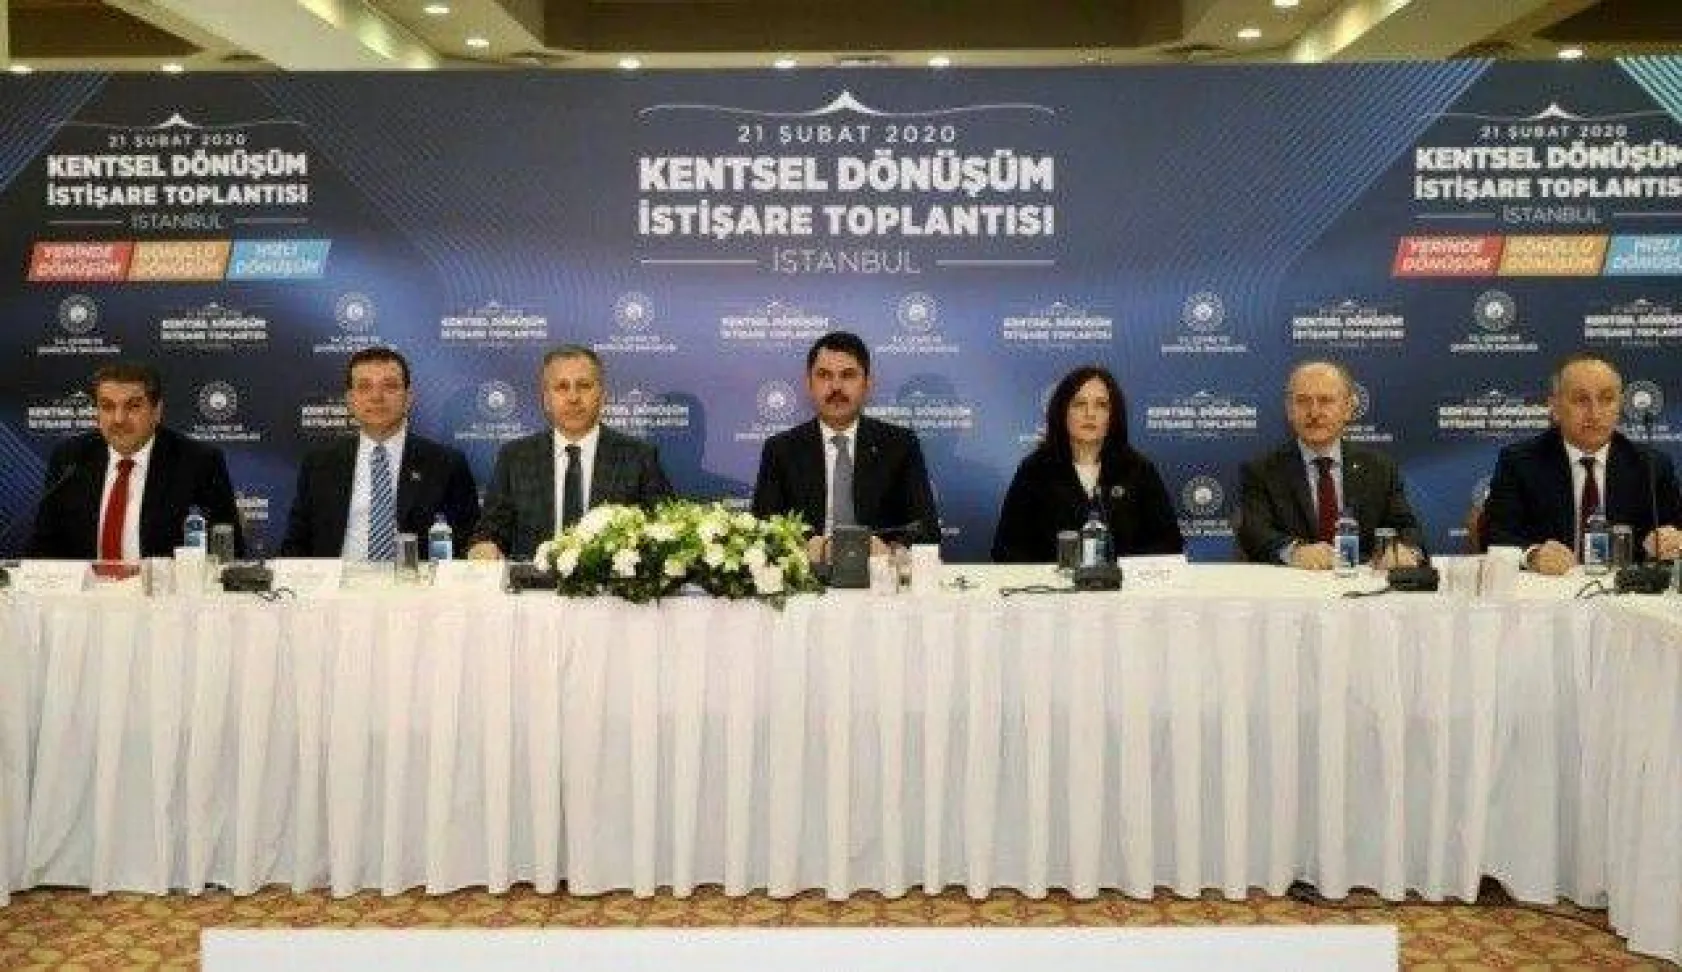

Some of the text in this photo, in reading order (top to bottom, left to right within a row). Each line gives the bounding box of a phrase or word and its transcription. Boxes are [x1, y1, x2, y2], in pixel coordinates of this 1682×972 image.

[202, 133, 247, 146] 2020
[738, 125, 956, 145] 21 ŞUBAT 2020
[47, 149, 309, 180] KENTSEL DÖNÜŞÜM
[1415, 146, 1541, 169] KENTSEL
[640, 149, 1055, 198] KENTSEL DÖNÜŞÜM
[47, 183, 309, 209] İSTİŞARE TOPLANTISI
[1415, 174, 1682, 202] İSTİŞARE TOPLANTIS
[640, 200, 1055, 239] İSTİŞARE TOPLANTISI
[773, 247, 921, 274] İSTANBUL
